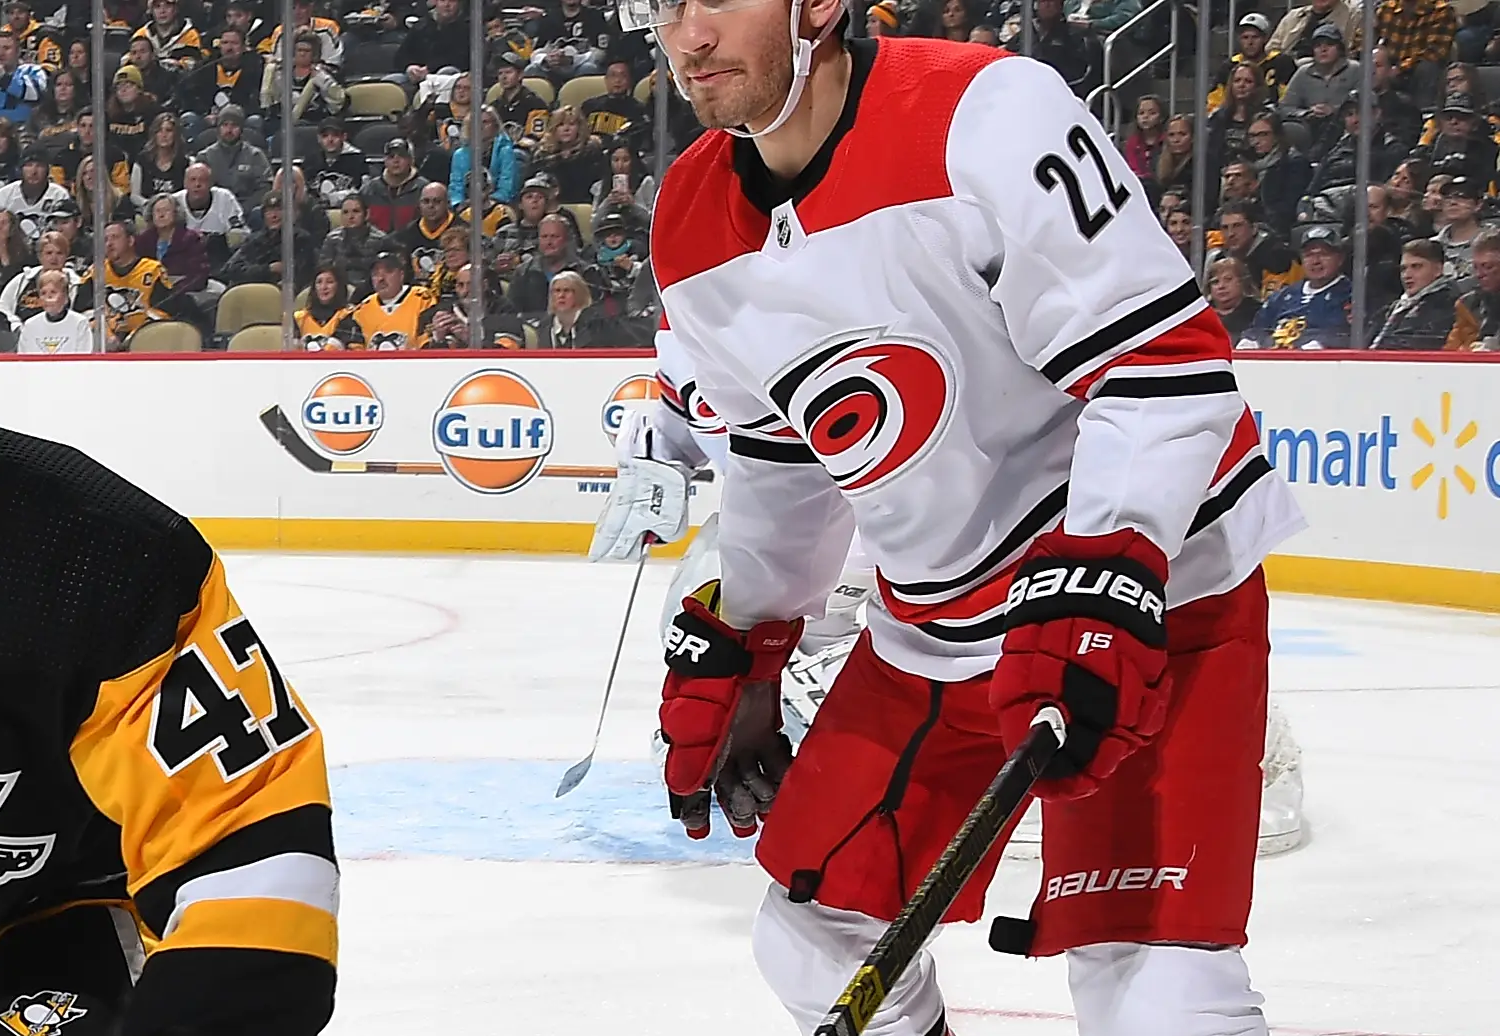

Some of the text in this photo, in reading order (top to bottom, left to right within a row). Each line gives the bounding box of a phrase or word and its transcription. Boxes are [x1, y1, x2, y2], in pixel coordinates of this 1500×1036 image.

[1034, 124, 1132, 243] 22
[305, 402, 378, 425] Gulf
[438, 412, 547, 448] Gulf
[1254, 410, 1399, 490] lmart
[1005, 566, 1164, 625] BAUER
[146, 613, 316, 784] 47
[1044, 866, 1188, 902] BAUER
